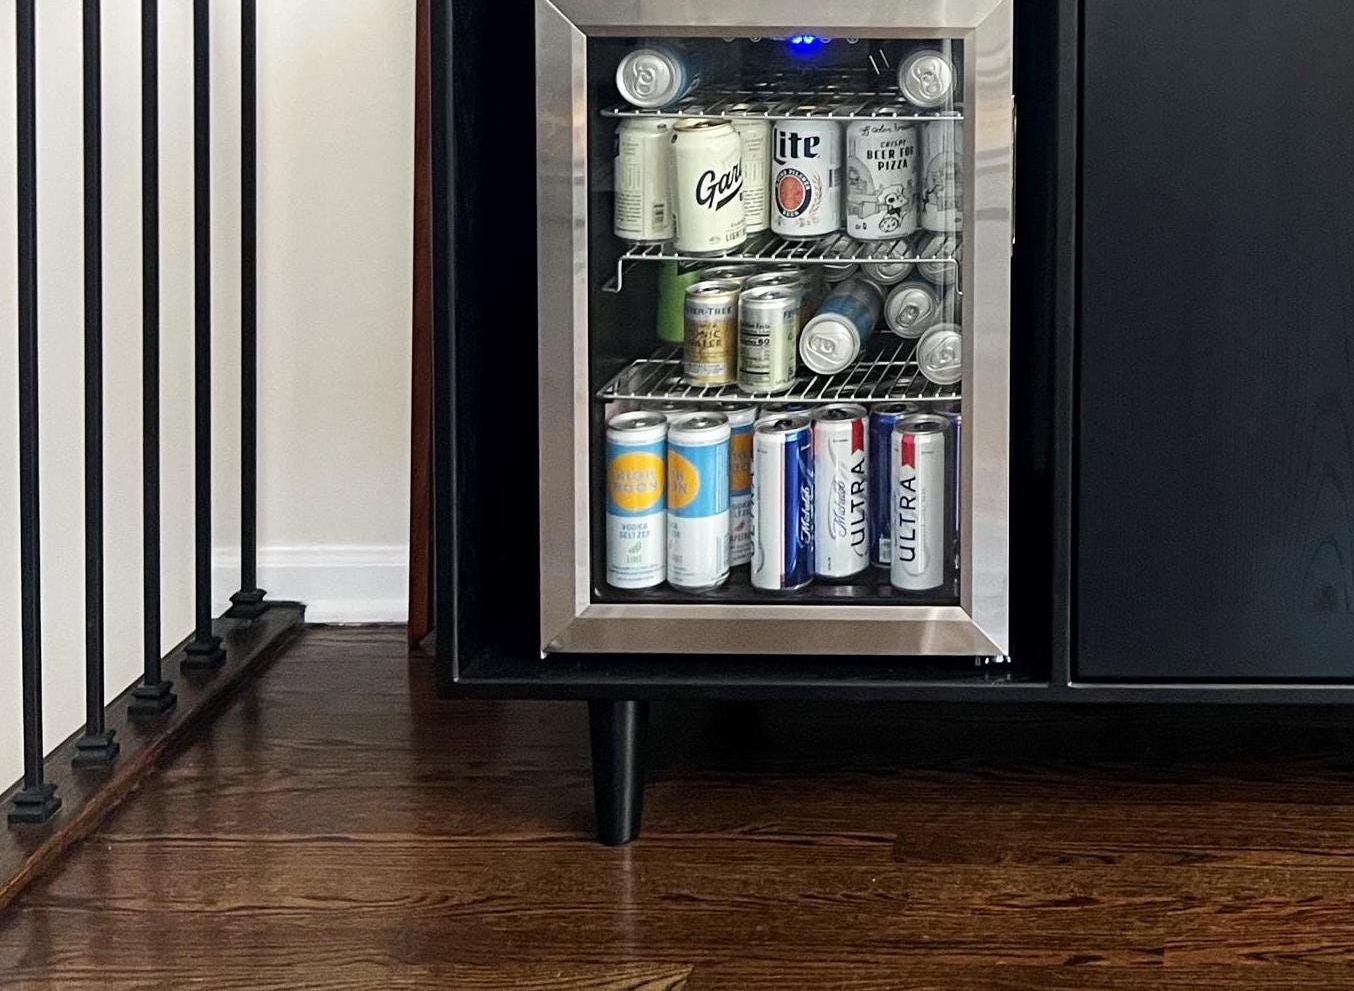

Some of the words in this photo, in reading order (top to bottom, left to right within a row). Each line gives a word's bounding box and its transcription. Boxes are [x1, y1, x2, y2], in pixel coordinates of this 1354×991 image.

[773, 128, 821, 166] Lite
[867, 149, 896, 160] BEER
[880, 139, 907, 148] CRISPY
[878, 158, 908, 171] PIZZA
[832, 480, 847, 538] Michelob
[851, 457, 866, 548] ULTRA
[899, 475, 916, 563] ULTRA
